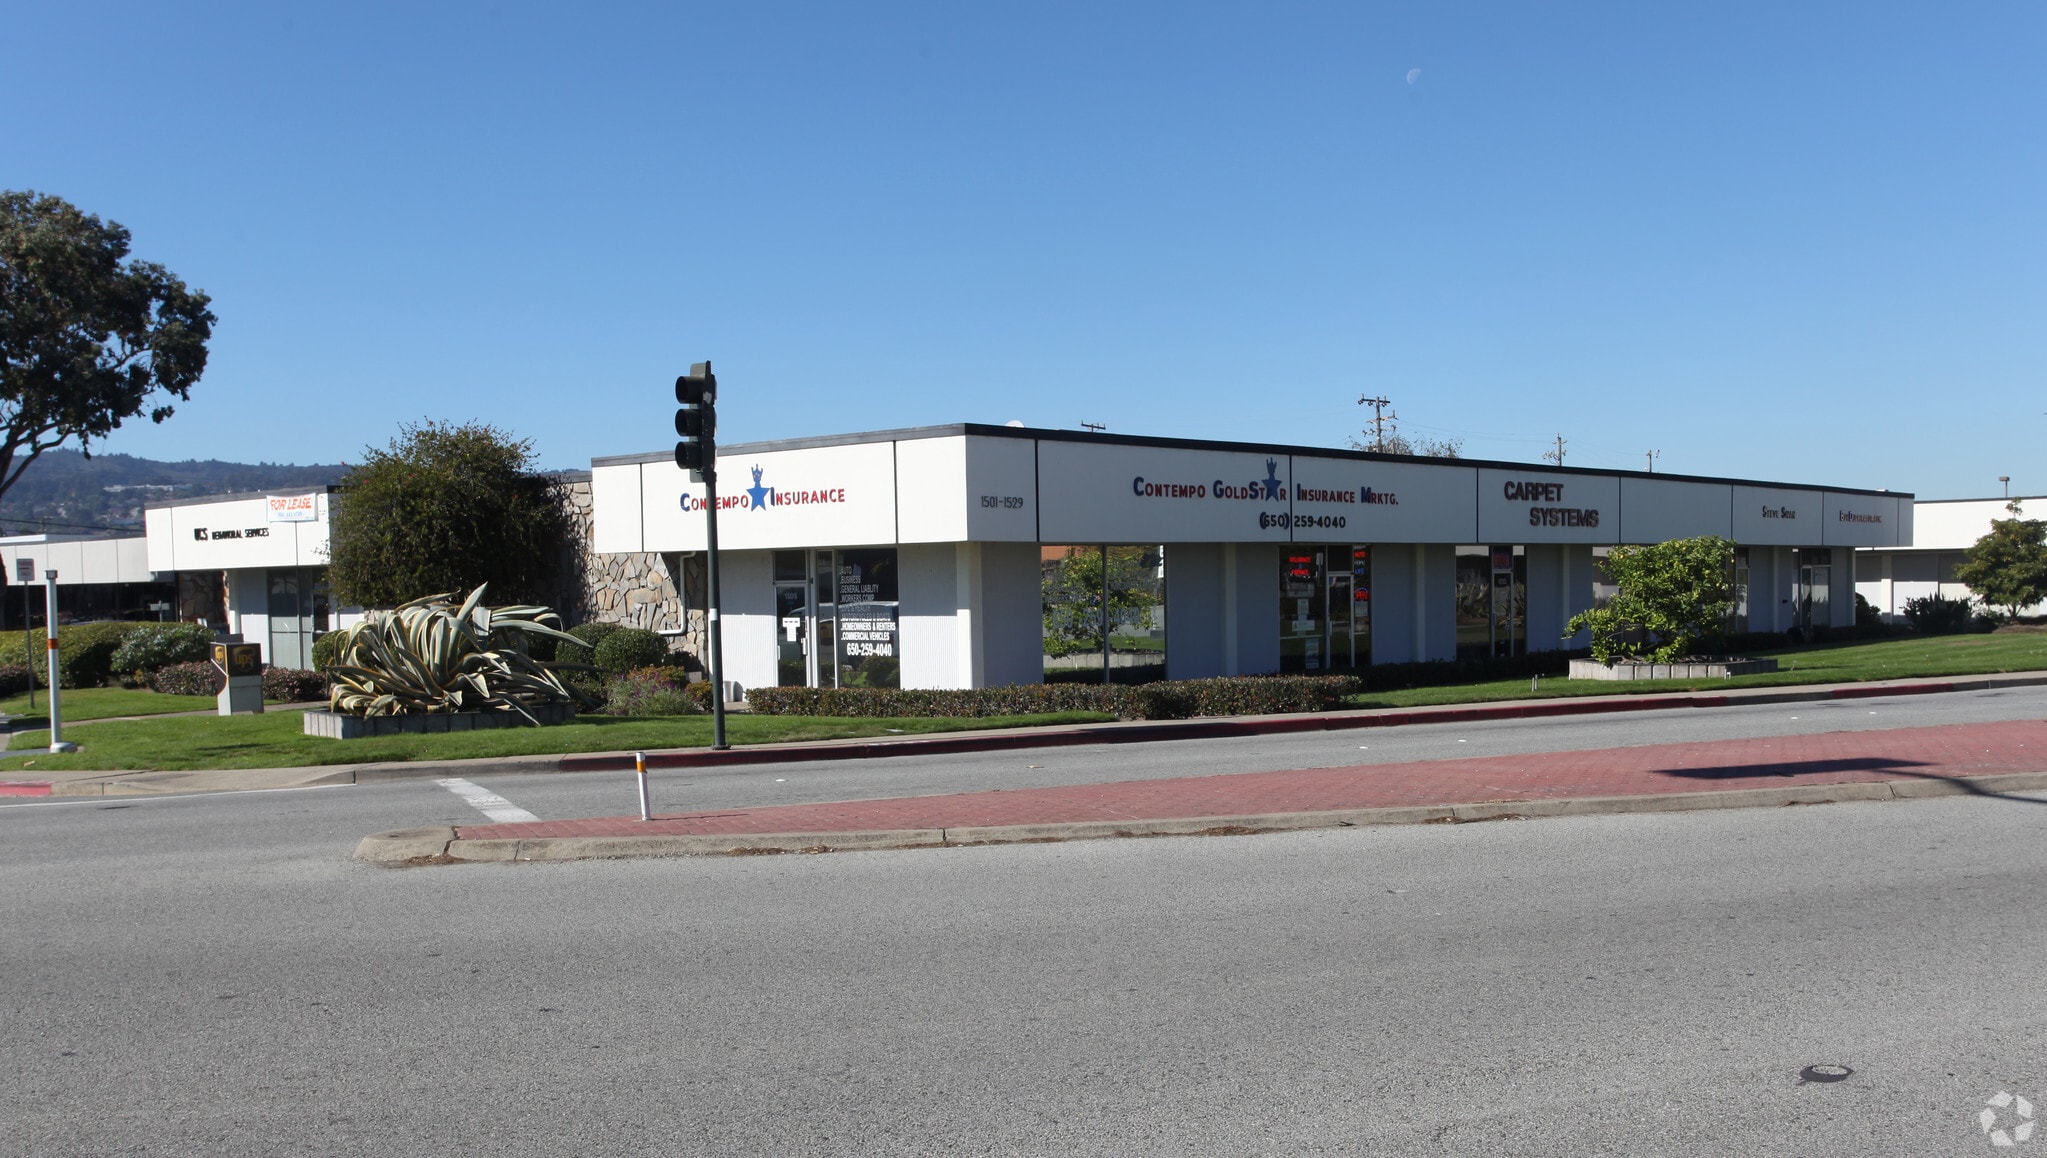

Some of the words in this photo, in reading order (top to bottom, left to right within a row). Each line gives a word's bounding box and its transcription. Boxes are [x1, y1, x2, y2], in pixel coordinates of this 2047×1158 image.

[1133, 476, 1206, 499] CONTEMPO
[1296, 483, 1356, 504] INSURANCE
[1504, 480, 1564, 502] CARPET
[270, 499, 287, 511] FOR
[287, 497, 312, 510] LEASE
[680, 492, 749, 512] CONEMPO
[769, 487, 846, 506] INSURANCE
[980, 495, 1024, 509] 1501-1529
[1259, 511, 1290, 530] (650)
[1293, 514, 1347, 529] 259-4040
[1529, 506, 1600, 528] SYSTEMS
[876, 622, 896, 631] RENTERS
[869, 631, 890, 641] VEHICLES
[846, 642, 893, 657] 650-259-4040
